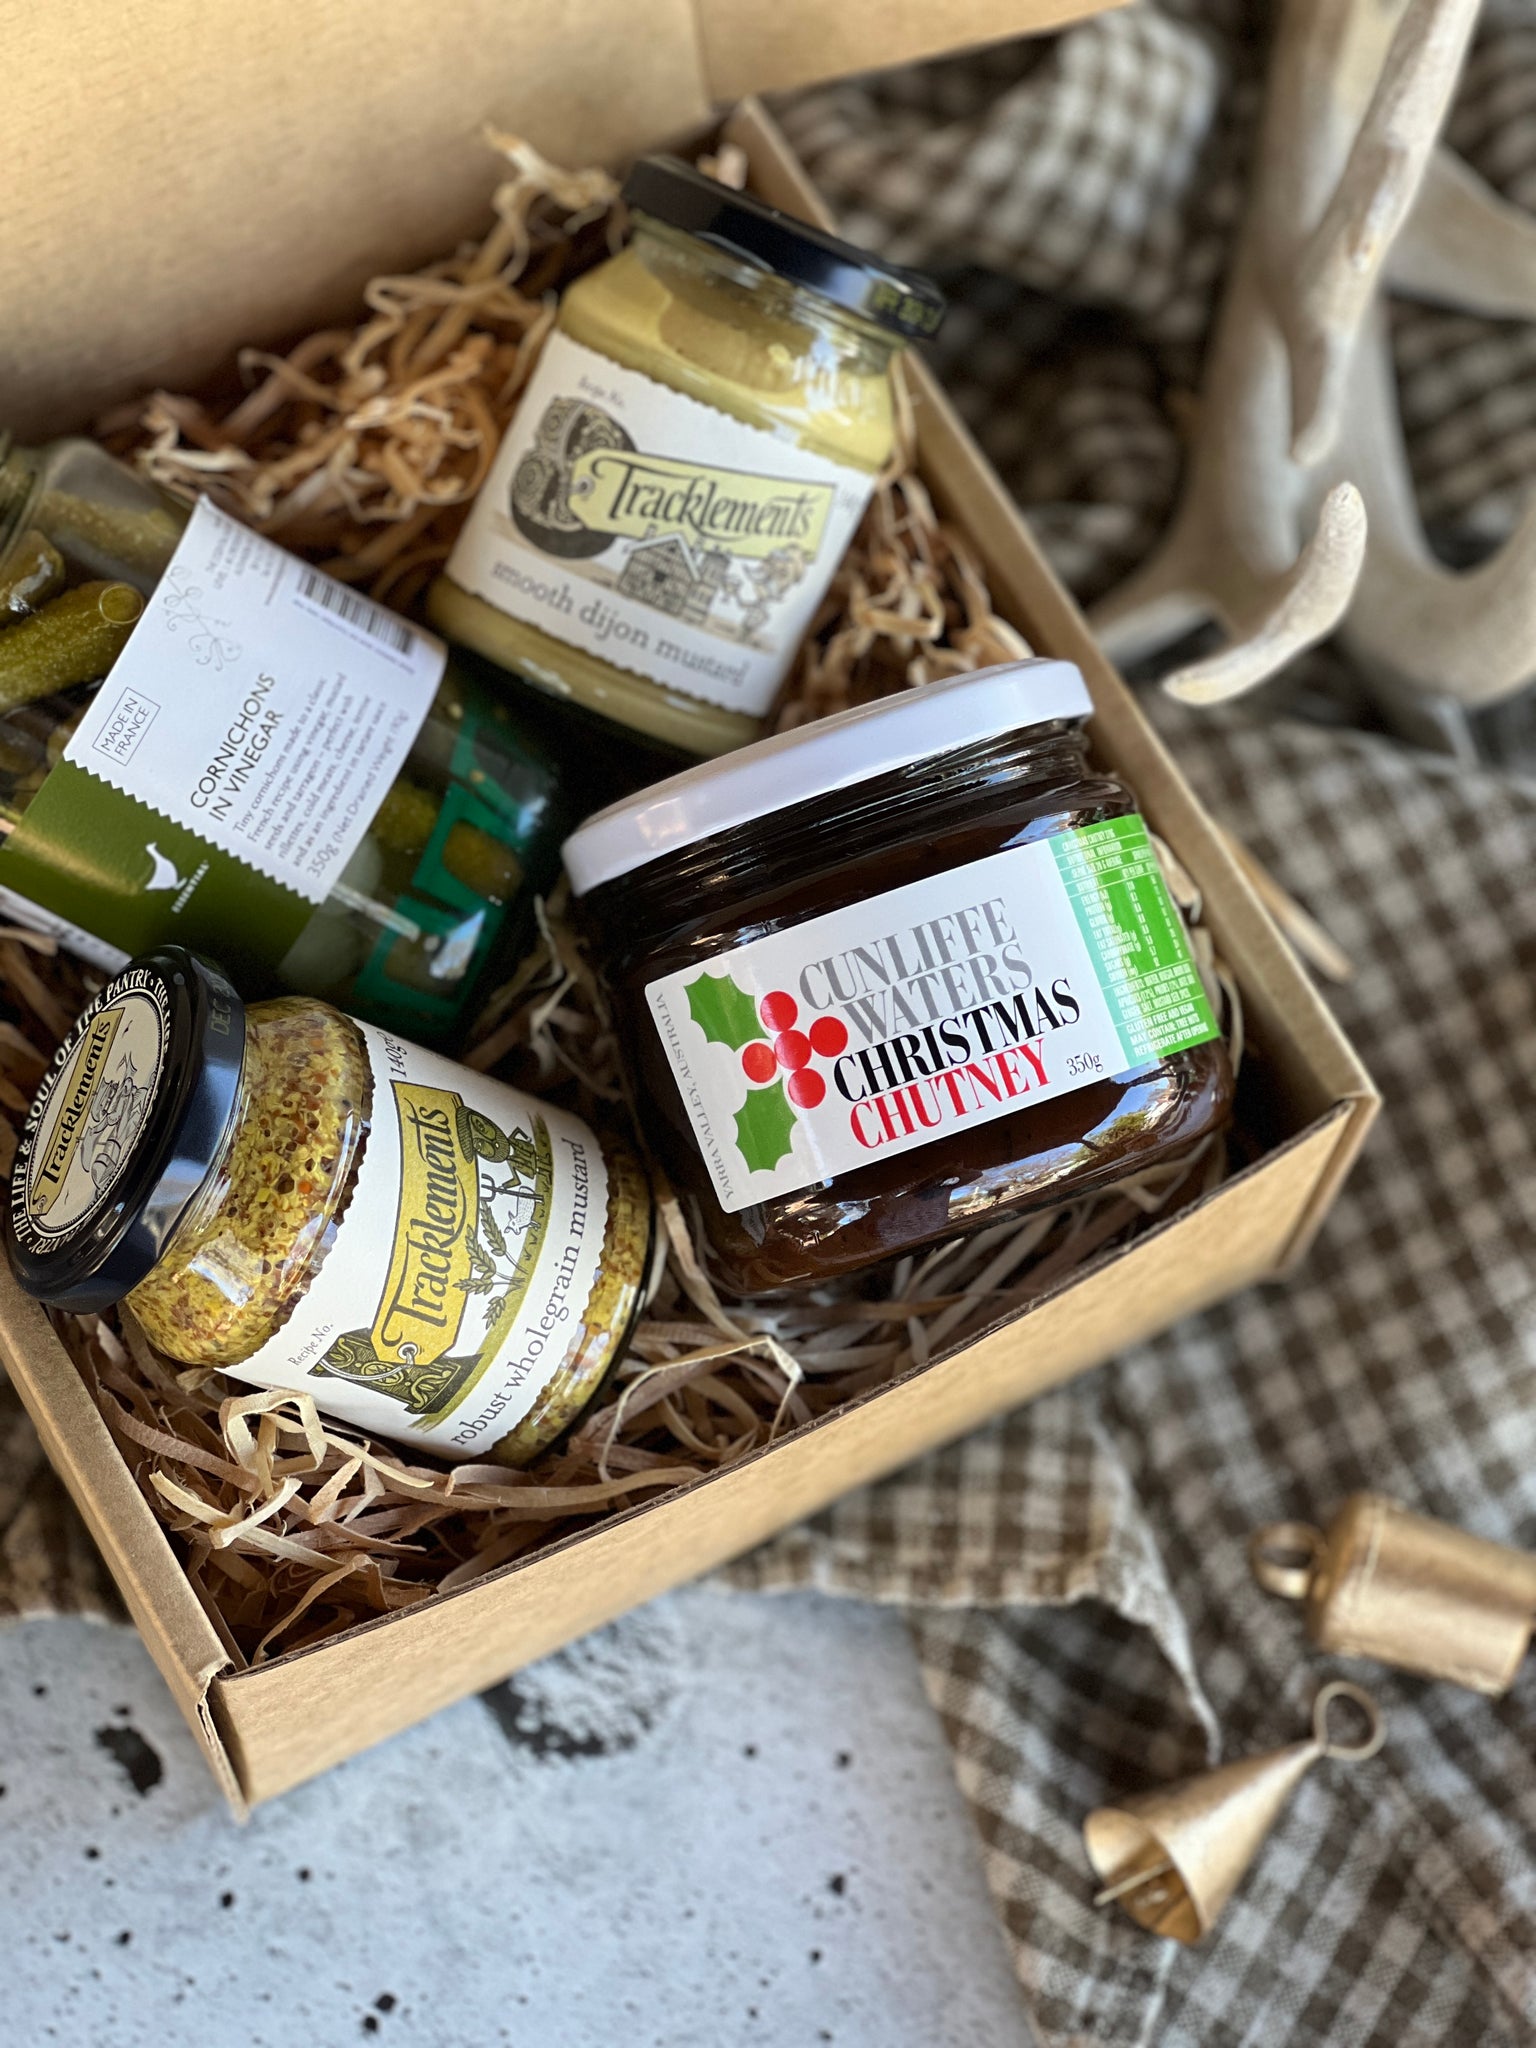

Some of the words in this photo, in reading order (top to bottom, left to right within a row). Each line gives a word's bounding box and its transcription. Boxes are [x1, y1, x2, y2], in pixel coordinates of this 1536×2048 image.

[591, 457, 814, 540] Tracklements
[492, 559, 573, 615] smooth
[579, 600, 649, 654] dijon
[655, 637, 750, 687] mustard
[99, 711, 130, 751] MADE
[122, 696, 138, 714] IN
[113, 705, 150, 756] FRANCE
[189, 672, 275, 808] CORNICHONS
[207, 794, 233, 822] IN
[222, 709, 284, 792] VINEGAR
[231, 808, 255, 832] Tiny
[250, 753, 287, 810] cornichons
[282, 725, 302, 753] made
[245, 807, 275, 843] French
[270, 774, 294, 807] recipe
[289, 746, 311, 774] using
[263, 823, 284, 851] seeds
[280, 799, 297, 823] and
[291, 758, 321, 802] tarragon
[277, 820, 308, 860] rillettes,
[302, 790, 321, 818] cold
[315, 763, 339, 794] meats,
[292, 844, 308, 868] and
[304, 835, 315, 847] as
[311, 820, 323, 835] an
[318, 767, 353, 820] ingredient
[305, 842, 340, 879] 350g
[331, 814, 353, 844] (Net
[344, 770, 377, 817] Drained
[106, 968, 151, 1004] PANTRY
[799, 897, 1017, 1010] CUNLIFFE
[840, 942, 1032, 1044] WATERS
[54, 1034, 77, 1067] OF
[75, 993, 104, 1036] THE
[210, 1001, 233, 1036] DEC
[655, 992, 693, 1079] AUSTRALIA
[833, 977, 1080, 1101] CHRISTMAS
[1125, 1015, 1154, 1034] GLUTEN
[1151, 1010, 1169, 1025] FREE
[1129, 1031, 1148, 1046] MAY
[1133, 1033, 1178, 1057] REFRIGERATE
[24, 1071, 57, 1133] SOUL
[850, 1038, 1051, 1149] CHUTNEY
[1066, 1050, 1104, 1077] 350g
[19, 1138, 33, 1157] &
[32, 1019, 112, 1206] Tracklements
[686, 1081, 715, 1148] VALLEY,
[11, 1160, 29, 1211] LIFE
[710, 1147, 734, 1200] YARRA
[12, 1211, 32, 1243] THE
[380, 1097, 467, 1348] Tracklements
[451, 1391, 513, 1447] robust
[504, 1239, 582, 1392] wholegrain
[560, 1137, 592, 1241] mustard
[286, 1340, 319, 1366] Recipe
[309, 1323, 334, 1343] No.
